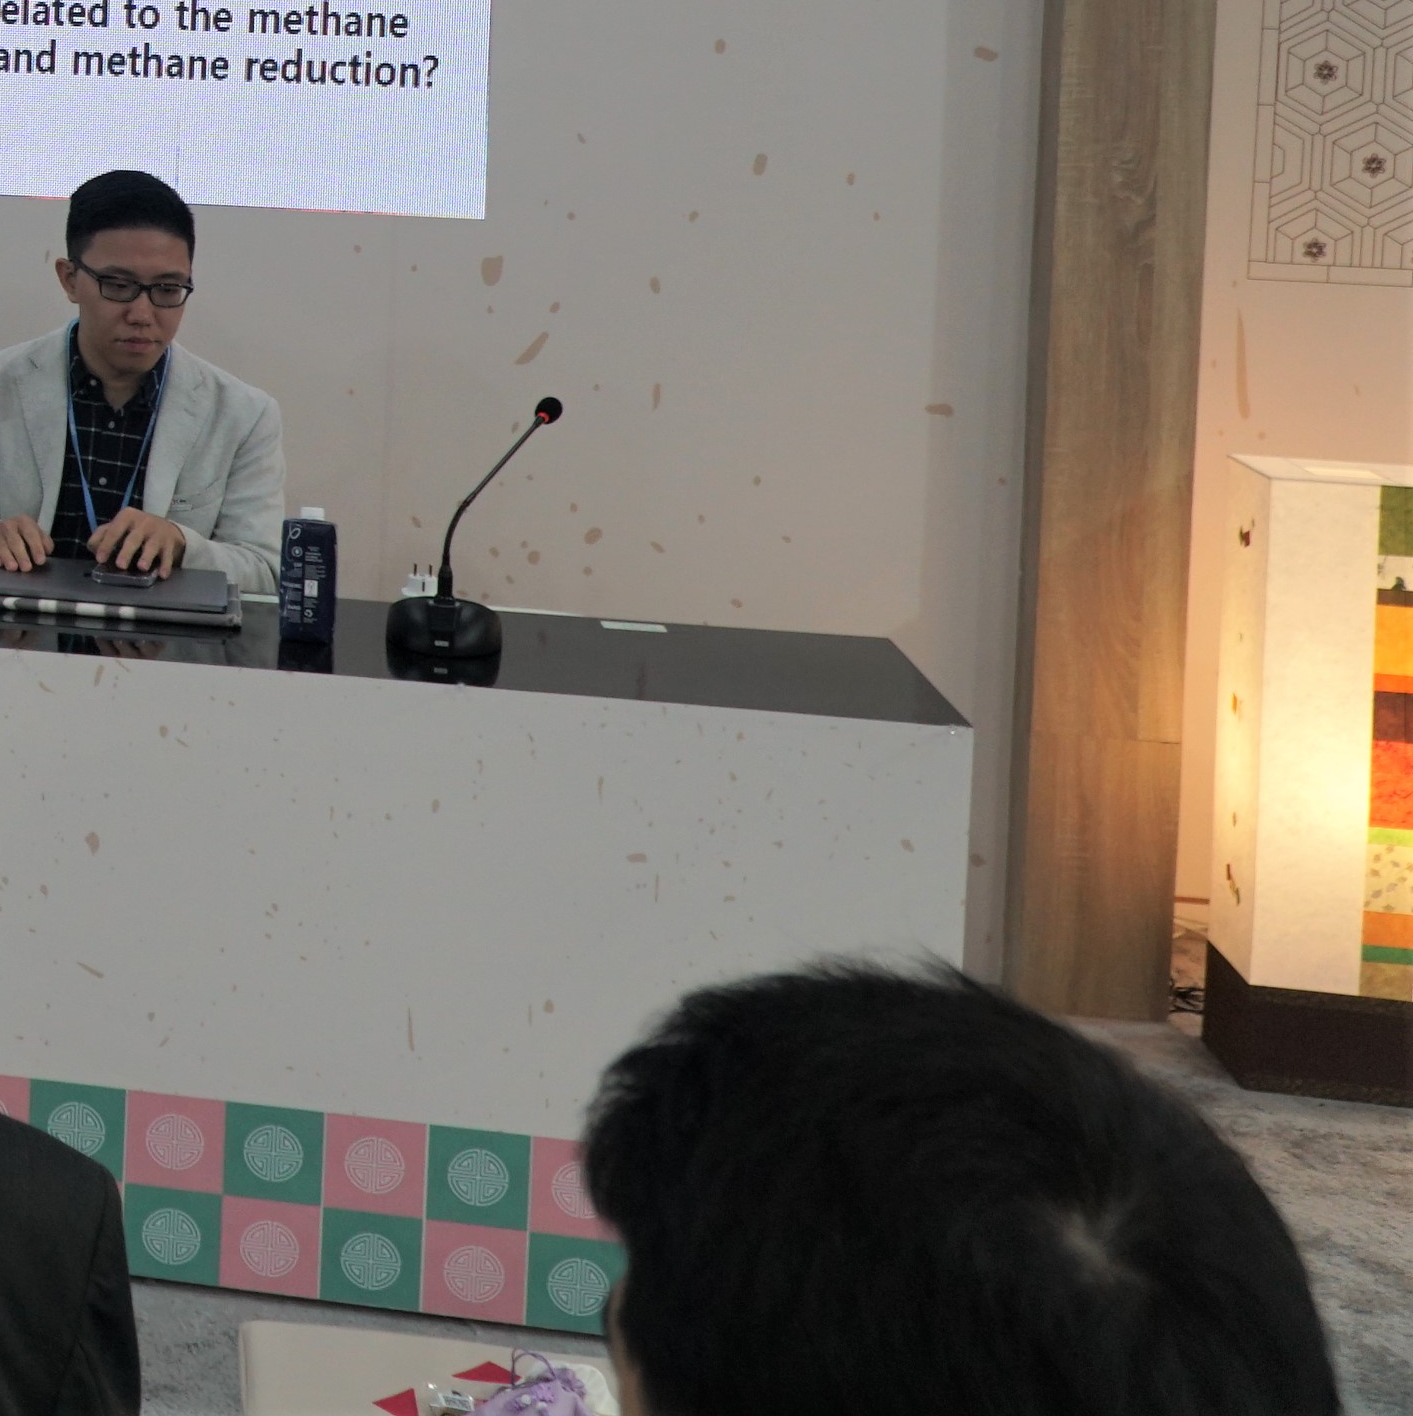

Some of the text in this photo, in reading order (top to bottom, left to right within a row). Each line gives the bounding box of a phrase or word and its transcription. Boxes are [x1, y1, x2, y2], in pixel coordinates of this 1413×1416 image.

[123, 0, 160, 30] to
[248, 0, 409, 39] methane
[72, 42, 230, 81] methane
[245, 48, 440, 88] reduction?
